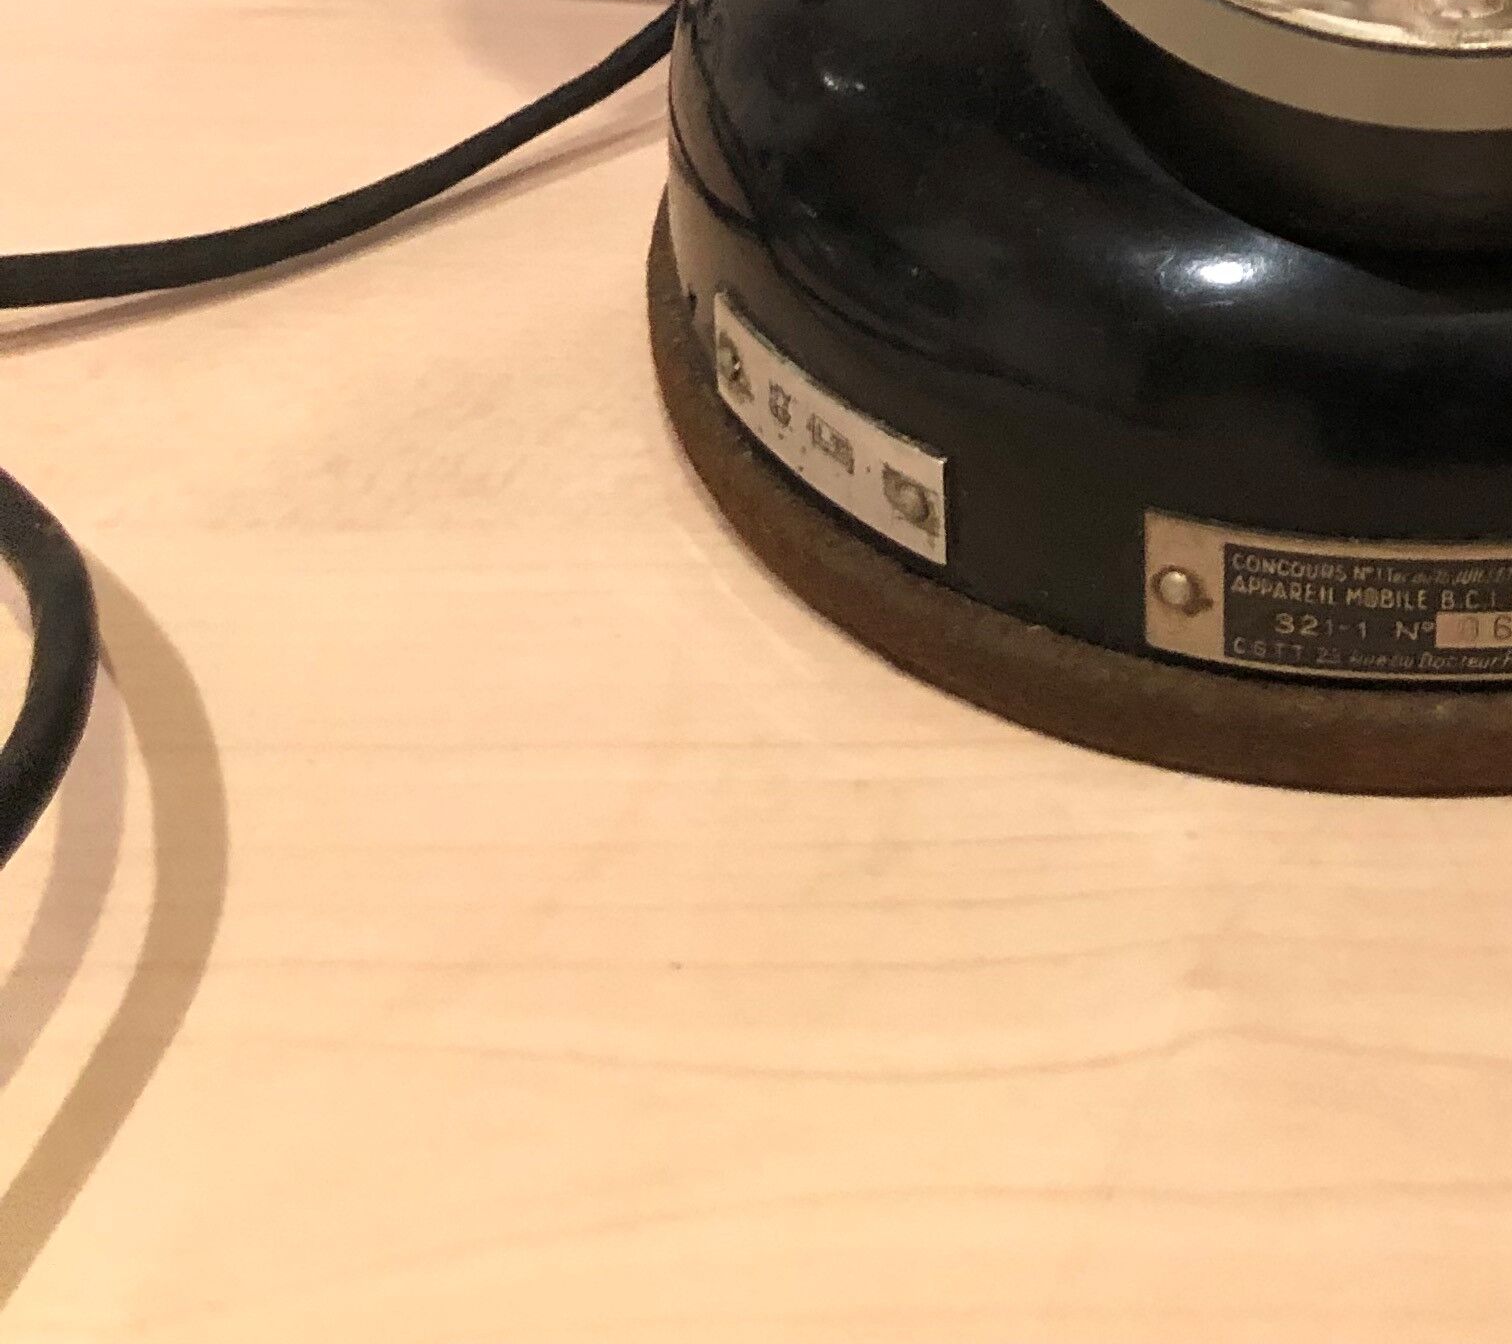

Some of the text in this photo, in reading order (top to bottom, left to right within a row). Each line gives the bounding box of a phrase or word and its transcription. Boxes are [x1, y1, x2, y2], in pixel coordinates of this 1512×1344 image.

[1230, 552, 1348, 583] CONCOURS
[1230, 574, 1336, 606] APPAREIL
[1345, 586, 1429, 611] MOBILE
[1274, 612, 1368, 641] 321-1
